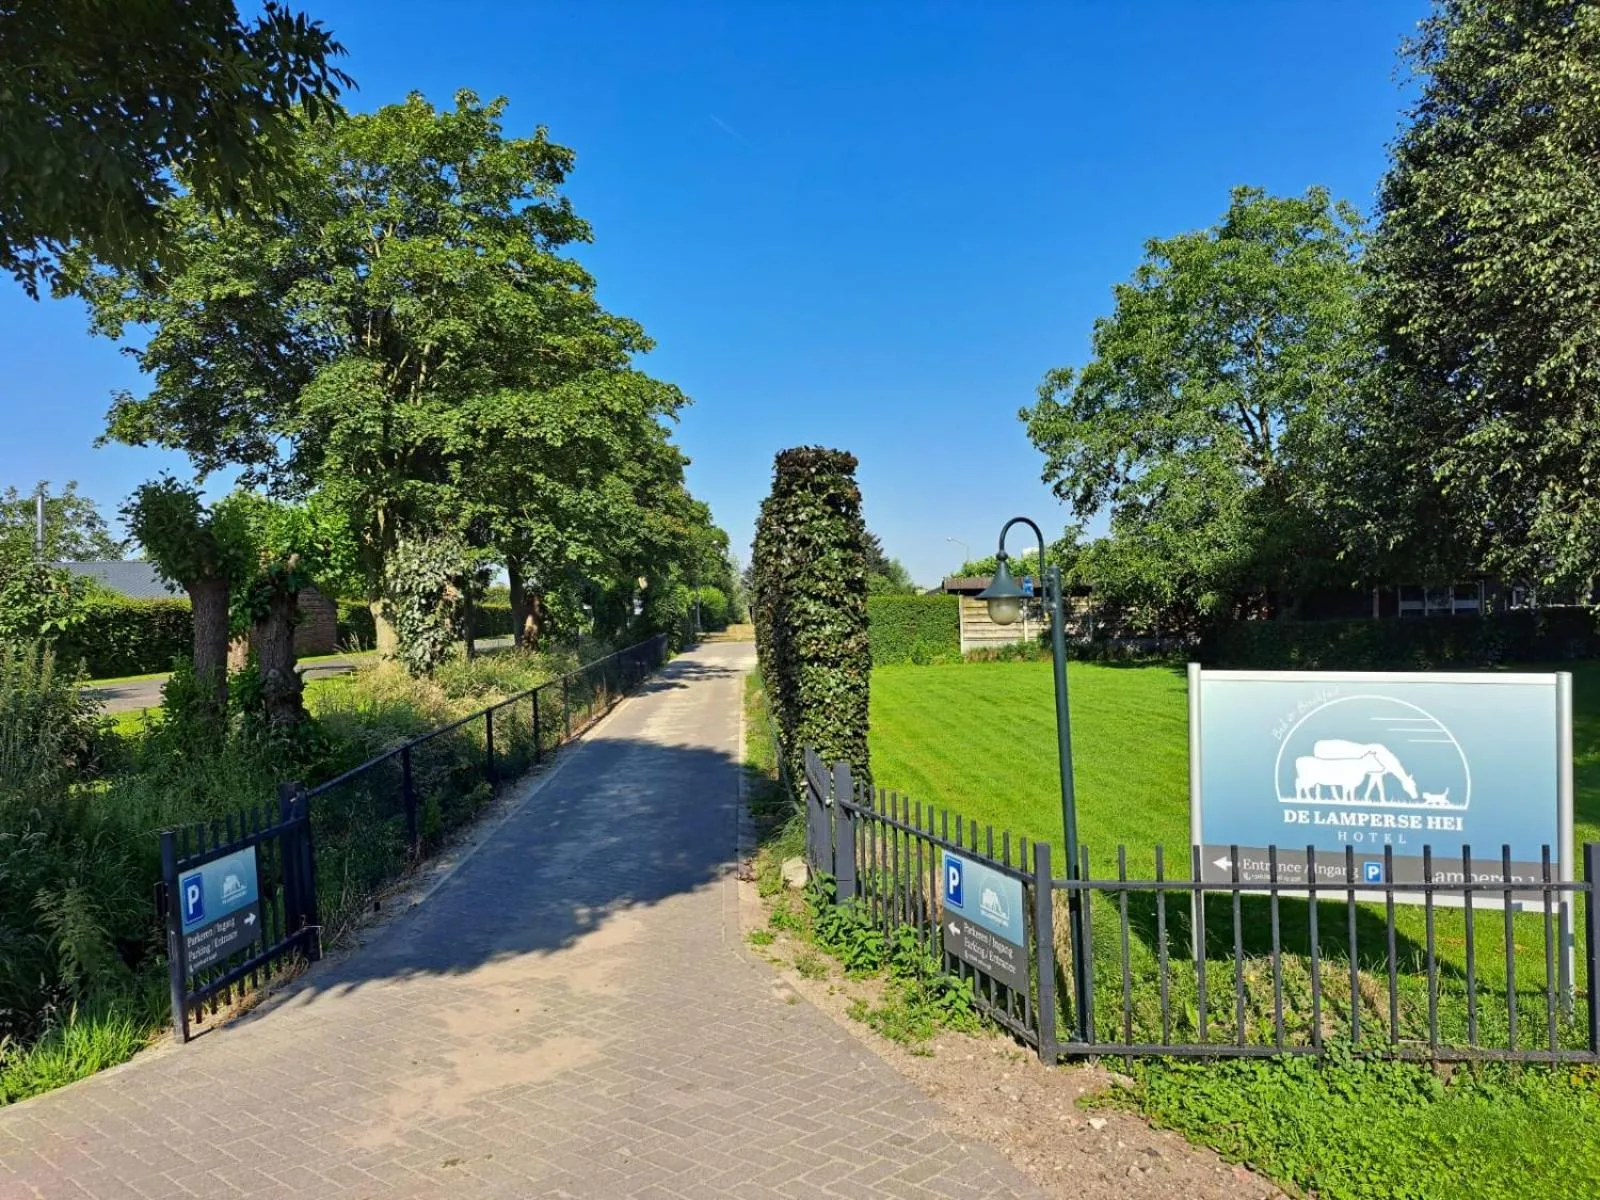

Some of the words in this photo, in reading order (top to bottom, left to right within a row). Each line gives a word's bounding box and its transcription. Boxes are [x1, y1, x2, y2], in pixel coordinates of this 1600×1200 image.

[1283, 809, 1310, 823] DE
[1314, 810, 1422, 829] LAMPERSE
[1427, 815, 1463, 831] HEI
[1337, 831, 1407, 844] HOTEL
[1243, 858, 1302, 874] Entrnce
[1367, 866, 1380, 880] P
[949, 866, 960, 895] P
[187, 884, 199, 915] P
